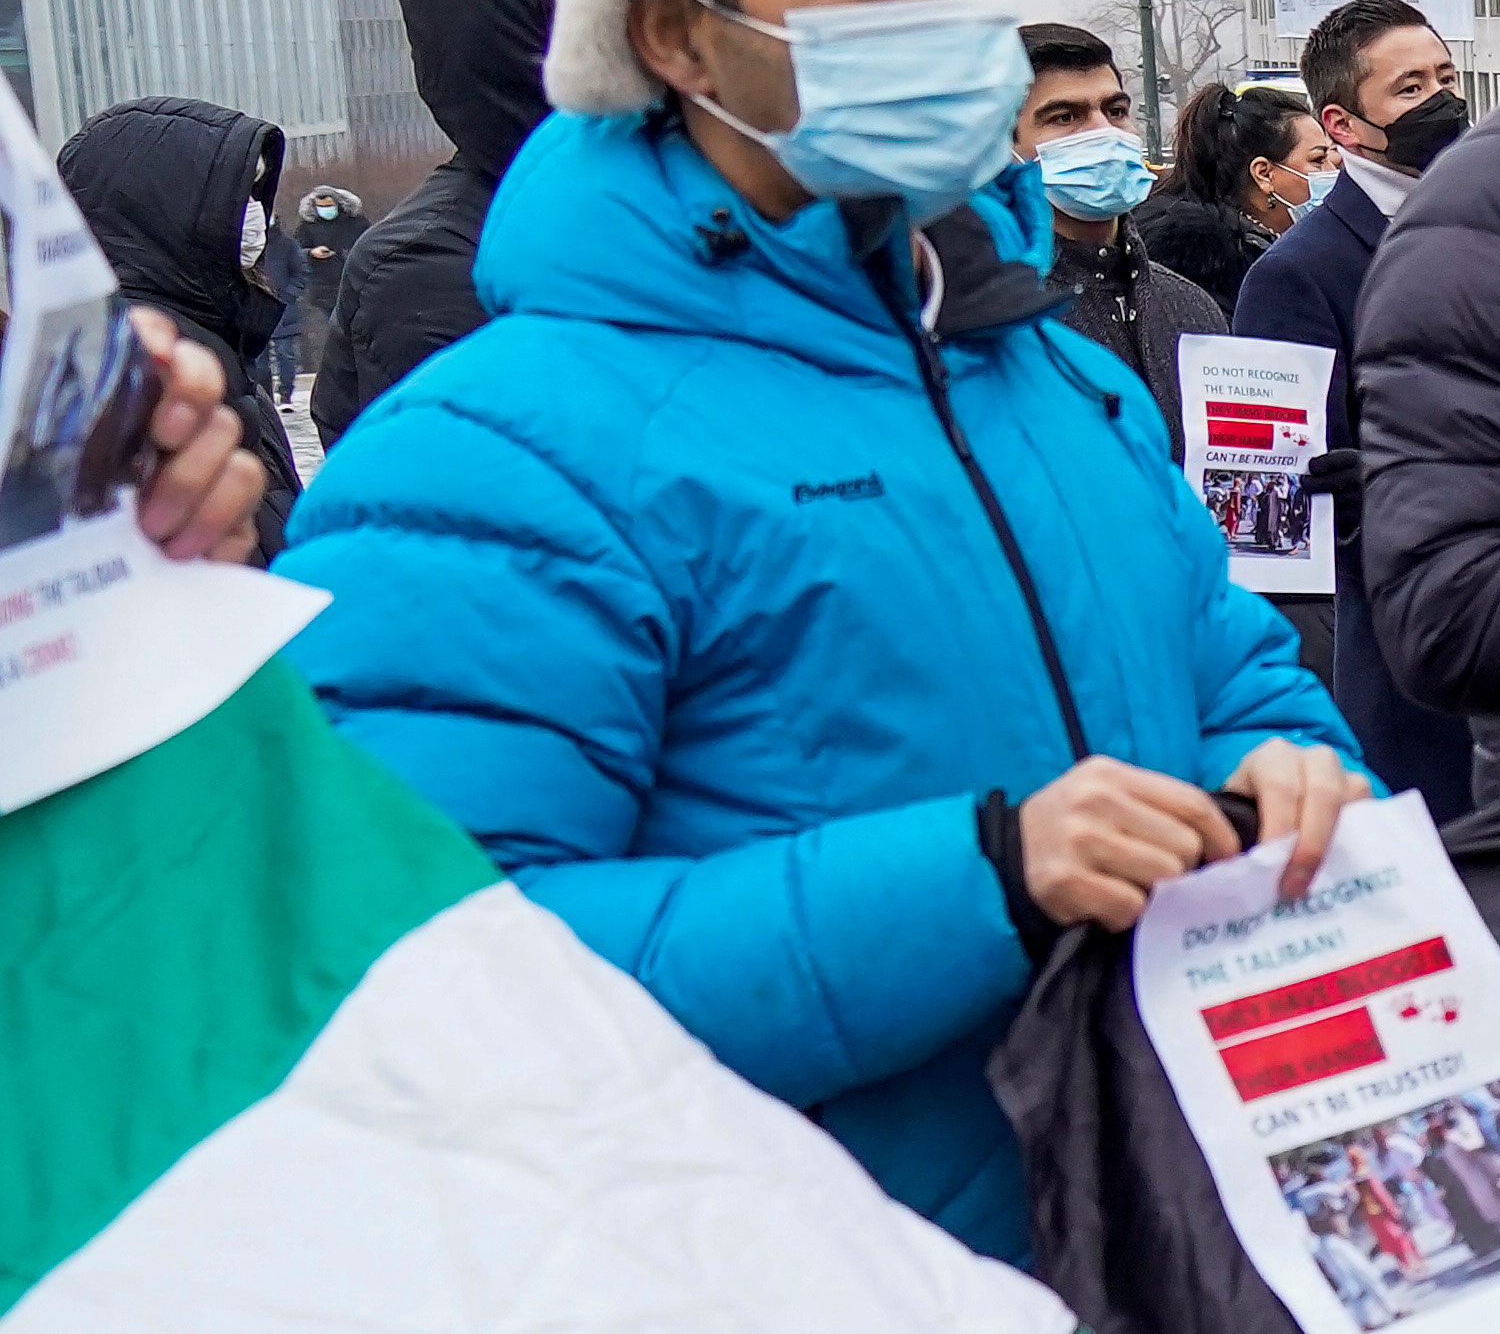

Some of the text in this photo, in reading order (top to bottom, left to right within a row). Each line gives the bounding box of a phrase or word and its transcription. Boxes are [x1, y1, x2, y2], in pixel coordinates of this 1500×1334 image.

[1203, 366, 1300, 384] DO NOT RECOGNIZE
[1204, 384, 1274, 398] THE TALIBAN!
[1238, 453, 1252, 464] BE
[1253, 454, 1298, 466] TRUSTED!
[1182, 922, 1218, 950] DO
[1186, 962, 1229, 990] THE
[1325, 1091, 1350, 1112] BE
